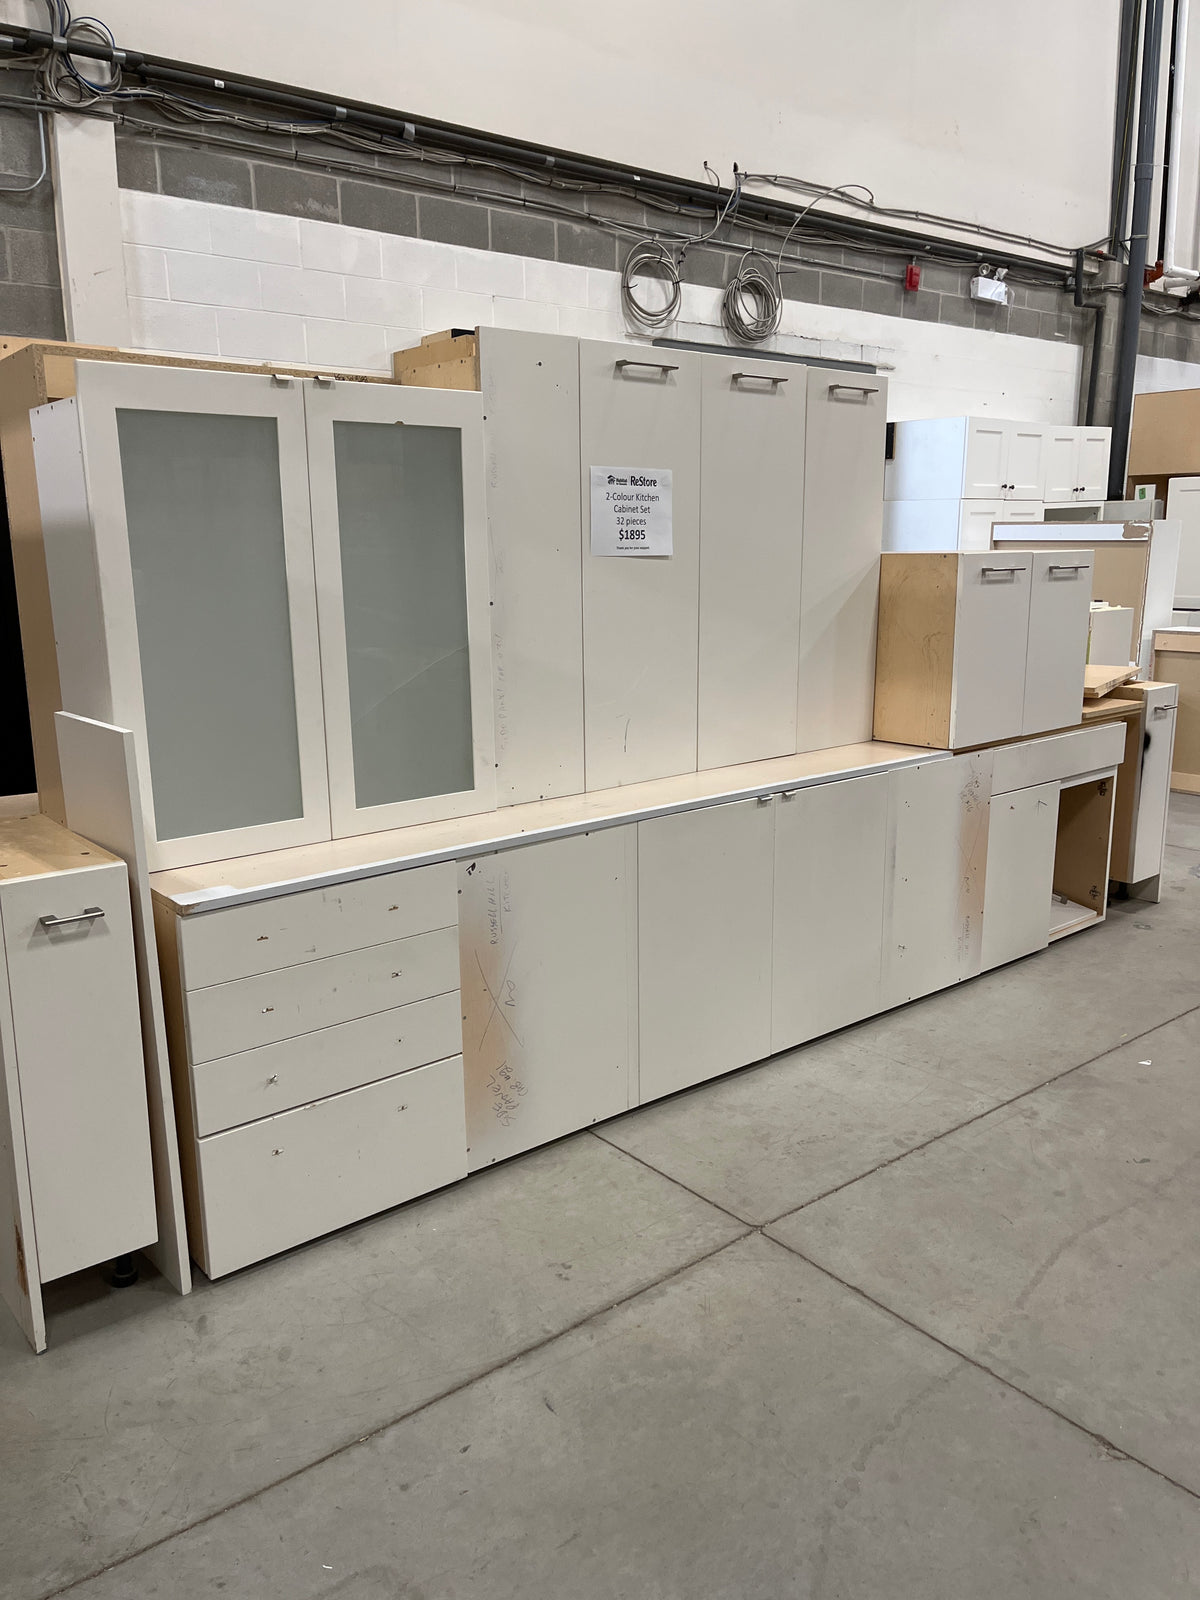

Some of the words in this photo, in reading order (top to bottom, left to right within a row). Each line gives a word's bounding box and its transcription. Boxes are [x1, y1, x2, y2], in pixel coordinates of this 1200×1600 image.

[630, 475, 658, 487] ReStore
[606, 491, 635, 501] 2-Colour
[636, 493, 660, 502] Kitchen
[613, 504, 639, 513] Cabinet
[640, 505, 651, 514] Set
[616, 516, 625, 525] 32
[626, 517, 647, 527] pieces
[619, 528, 646, 541] $1895
